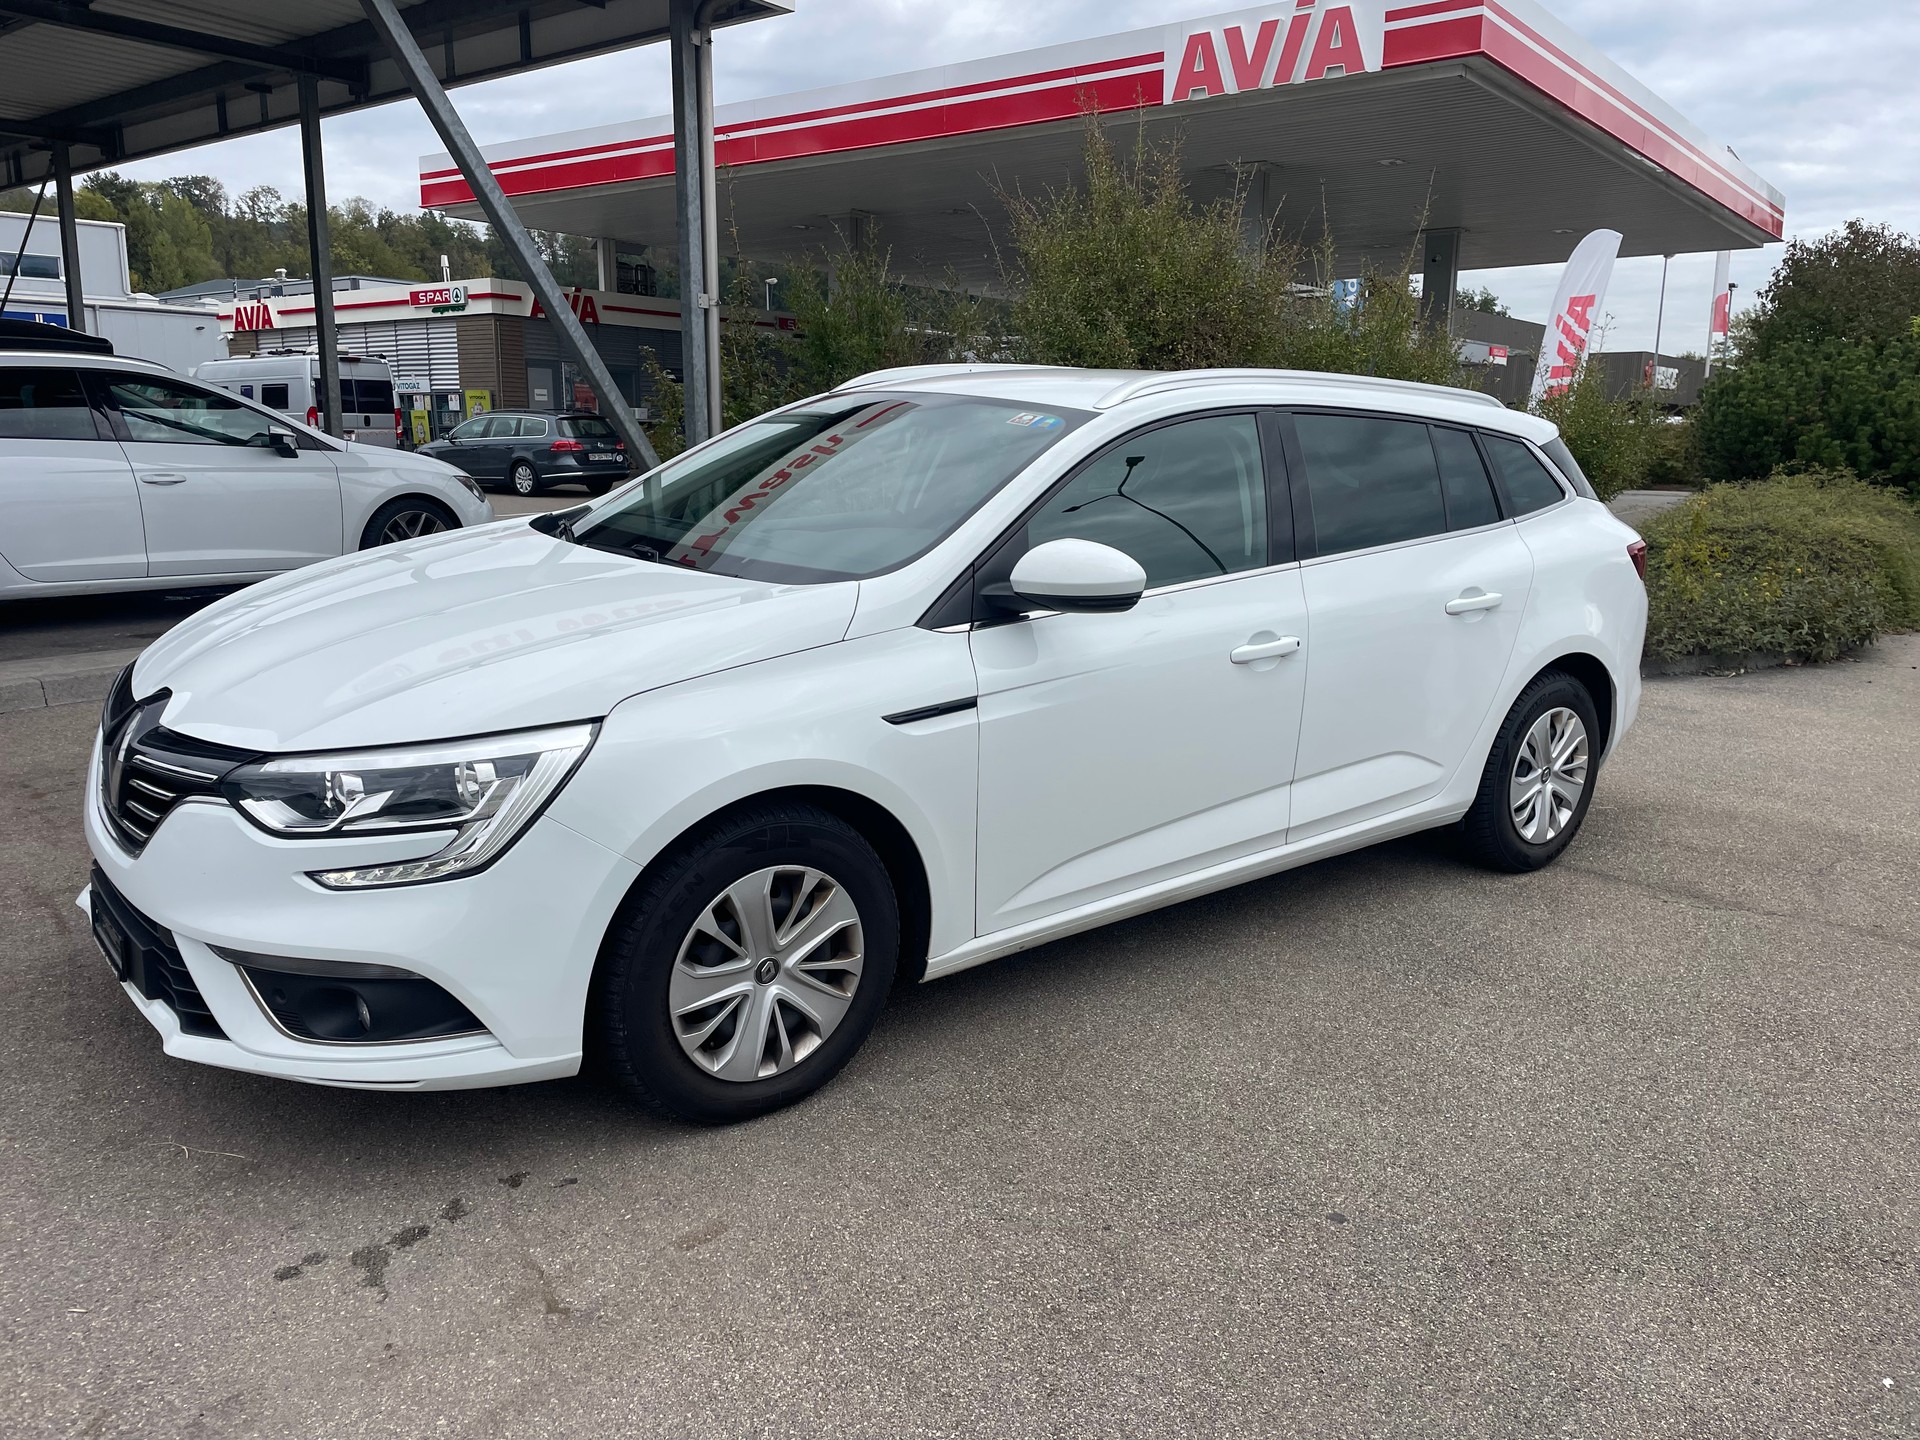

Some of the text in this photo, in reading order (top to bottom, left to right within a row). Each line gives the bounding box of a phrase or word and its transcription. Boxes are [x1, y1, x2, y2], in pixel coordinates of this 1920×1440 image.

[1171, 0, 1366, 102] AVIA
[418, 290, 450, 304] SPAR
[234, 298, 274, 331] AVIA
[397, 382, 421, 390] VITOGAZ
